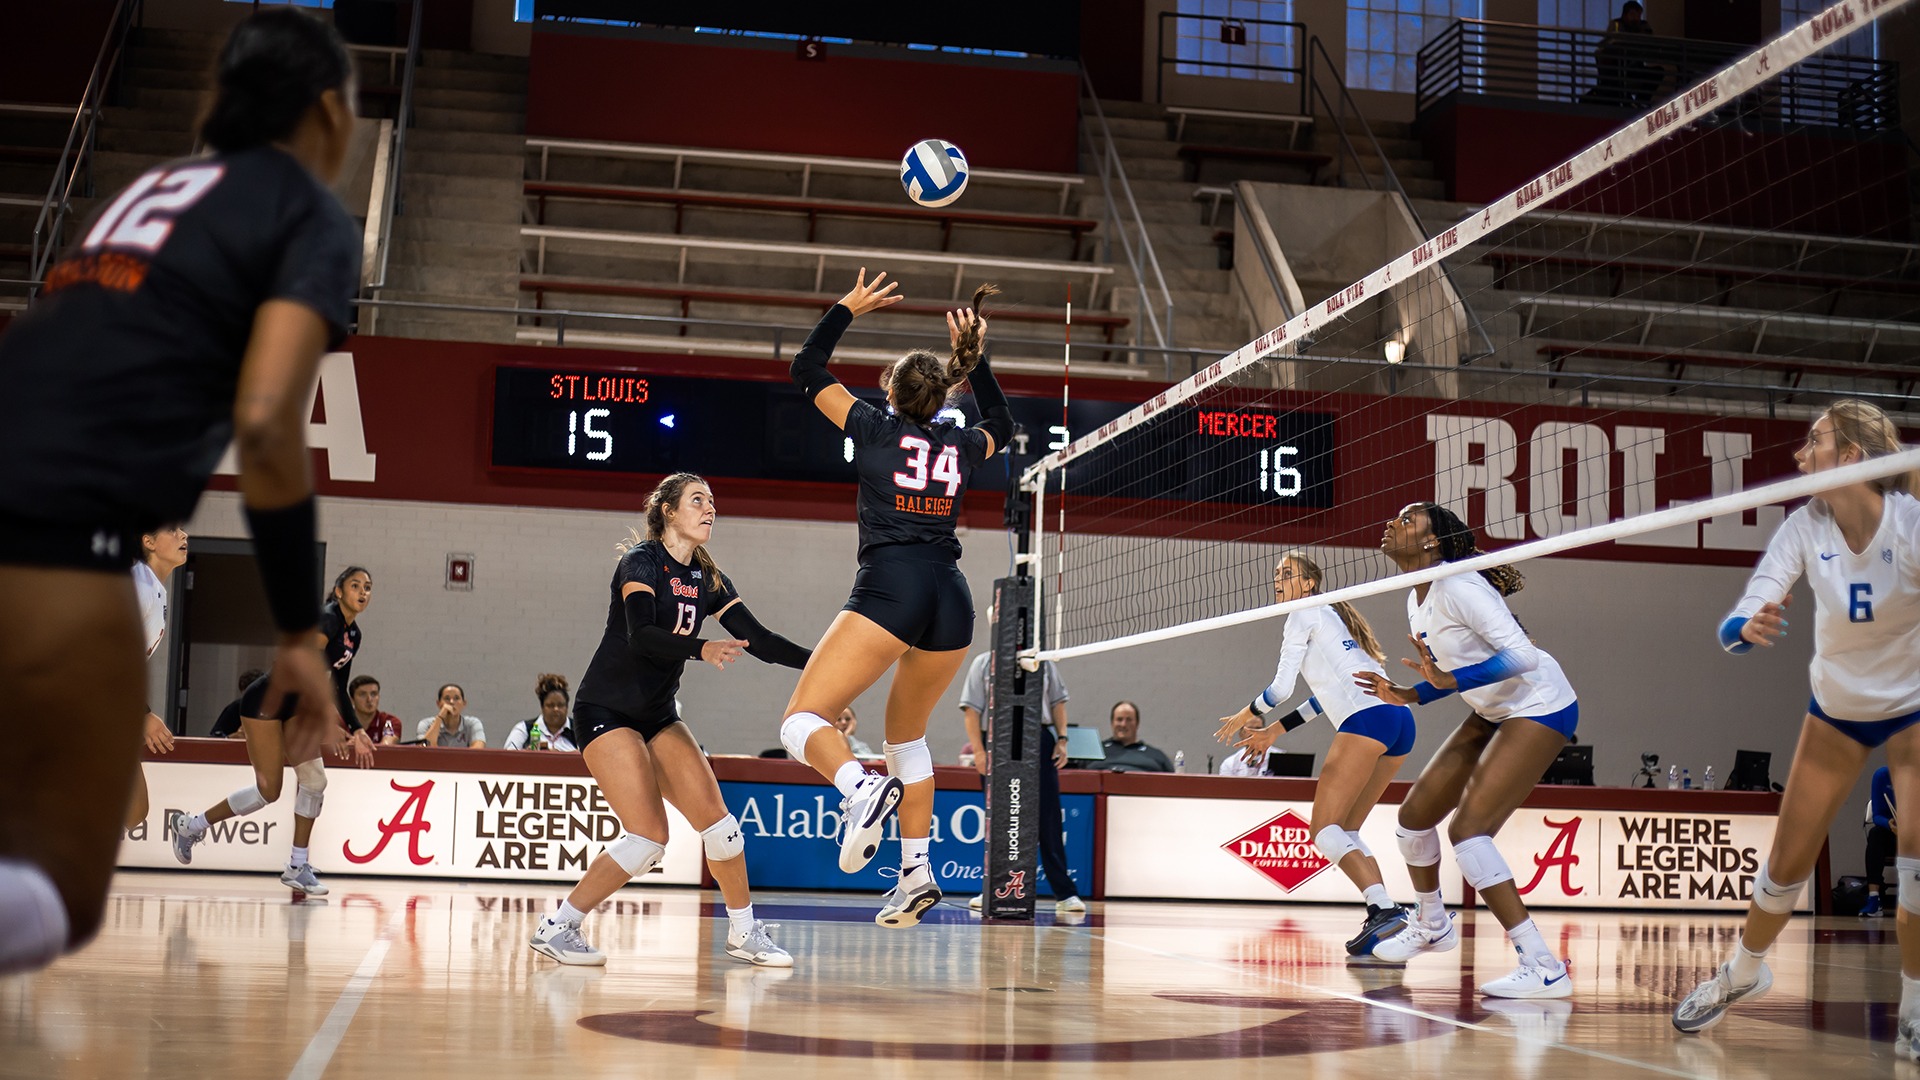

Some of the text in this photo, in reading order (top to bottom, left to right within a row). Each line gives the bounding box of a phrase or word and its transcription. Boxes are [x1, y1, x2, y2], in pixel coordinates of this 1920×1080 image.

[1811, 3, 1856, 44] ROLL
[806, 43, 817, 58] S
[1646, 78, 1719, 136] ROLL TIDE
[1516, 161, 1574, 210] ROLL TIDE
[81, 164, 227, 254] 12
[1412, 226, 1459, 268] ROLL TIDE
[1326, 280, 1364, 316] ROLL TIDE
[1254, 324, 1288, 355] ROLL TIDE
[567, 408, 613, 461] 15
[1198, 410, 1277, 439] MERCER
[893, 434, 962, 497] 34
[1260, 446, 1302, 497] 16
[1426, 414, 1785, 552] ROLL
[895, 494, 954, 517] RALEIGH
[672, 602, 697, 636] 13
[1849, 583, 1875, 623] 6
[479, 780, 610, 812] WHERE
[342, 778, 436, 866] A
[476, 811, 621, 843] LEGEND
[1006, 778, 1022, 861] sports imports
[1268, 825, 1311, 844] RED
[1618, 816, 1731, 845] WHERE
[475, 842, 549, 871] ARE
[1239, 840, 1328, 860] DIAMON
[1252, 859, 1320, 869] COFFEE & TEA
[1617, 845, 1759, 874] LEGENDS
[1618, 873, 1755, 901] ARE MAD
